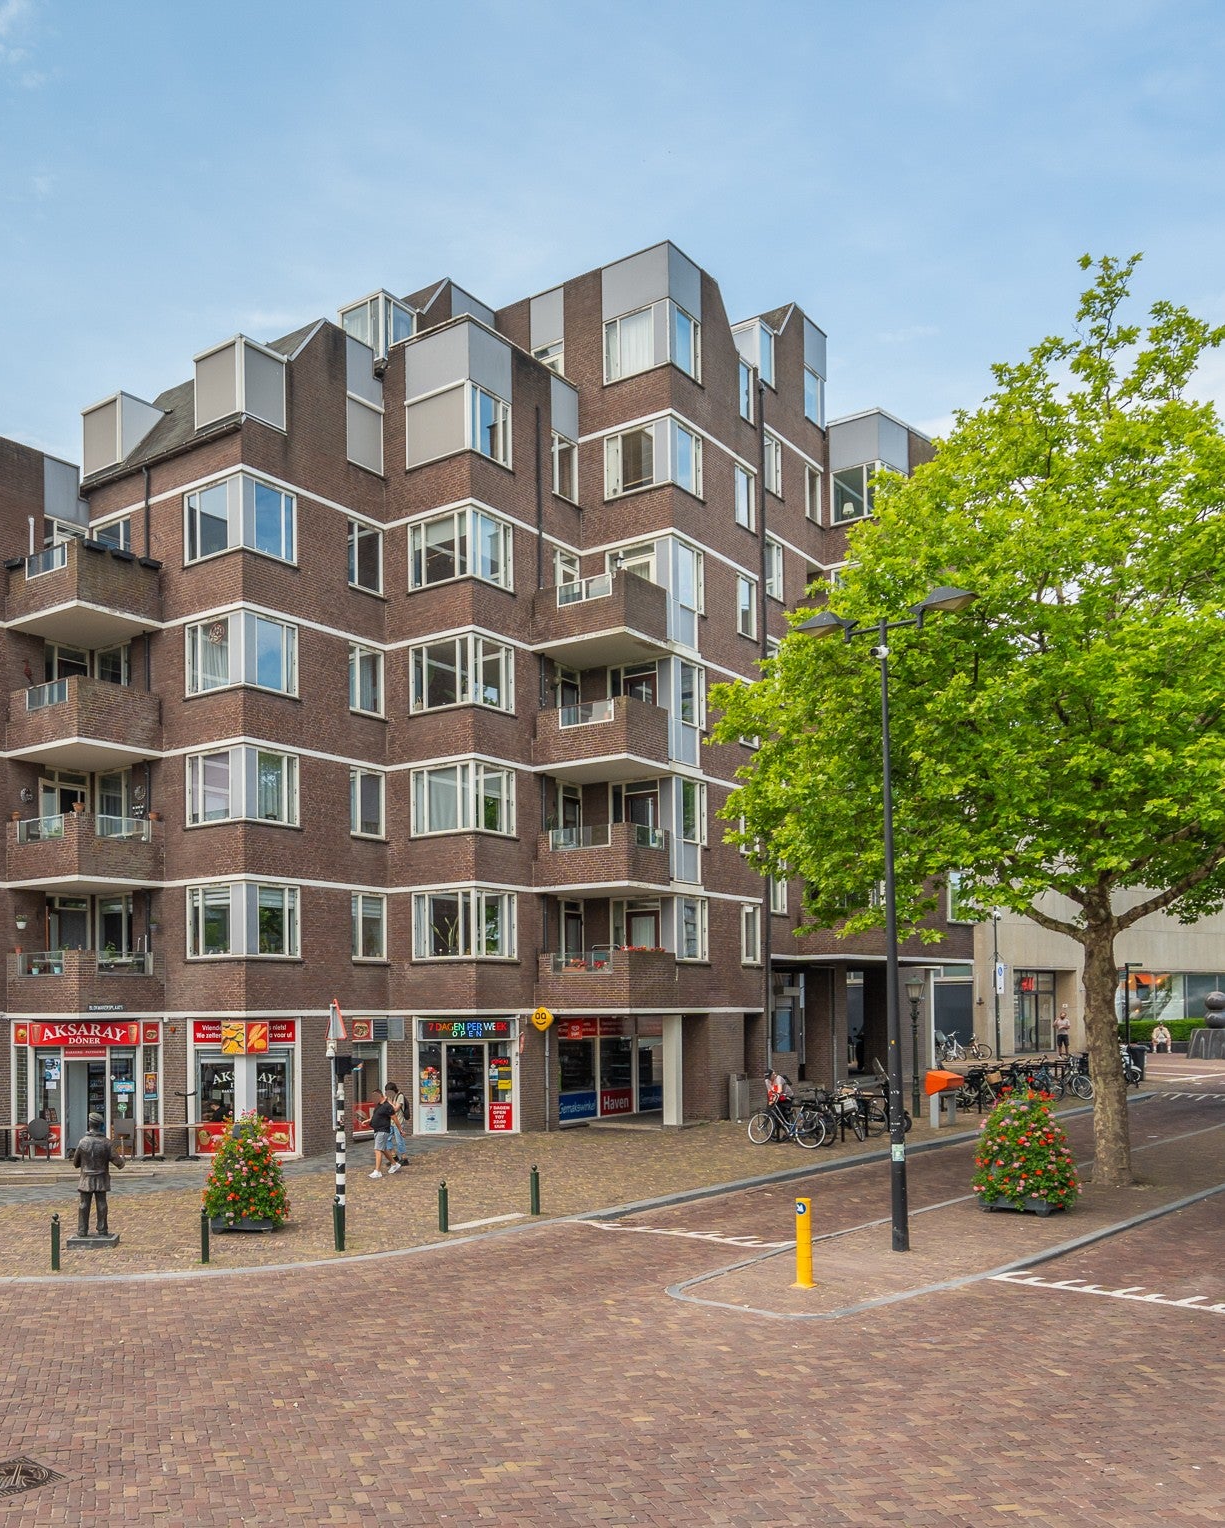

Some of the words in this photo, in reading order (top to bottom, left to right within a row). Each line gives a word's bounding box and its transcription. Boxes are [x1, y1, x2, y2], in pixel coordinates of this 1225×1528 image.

[42, 1023, 126, 1041] AKSARAY
[428, 1023, 434, 1031] 7
[435, 1023, 465, 1031] DAGEN
[466, 1023, 482, 1031] PER
[483, 1023, 507, 1031] WEEK
[452, 1030, 482, 1038] OPEN
[603, 1096, 629, 1115] Haven
